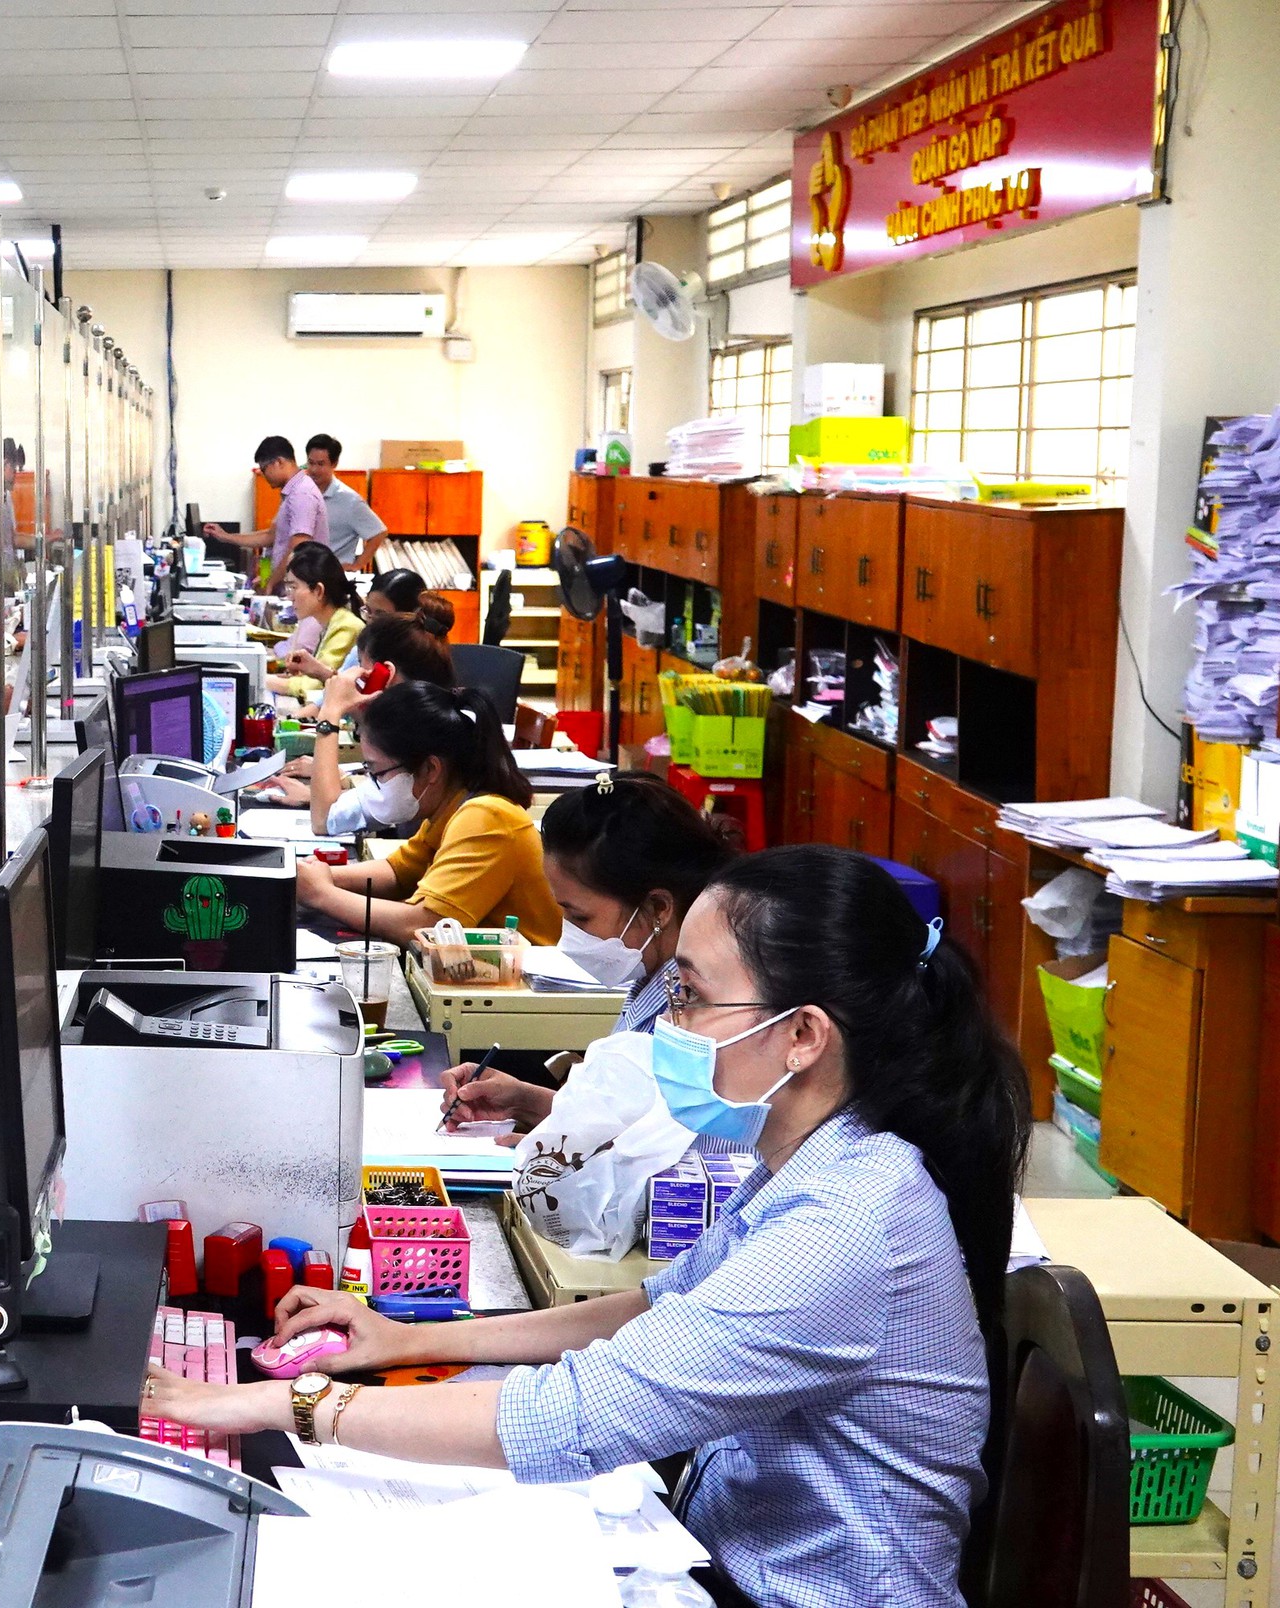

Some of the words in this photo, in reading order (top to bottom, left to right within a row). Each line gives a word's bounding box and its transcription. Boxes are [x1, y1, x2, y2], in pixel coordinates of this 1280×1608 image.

[901, 80, 927, 136] TIẾP
[929, 69, 966, 126] NHẬN
[969, 54, 988, 106] VÀ
[991, 33, 1020, 97] TRẢ
[1024, 15, 1058, 82] KẾT
[1060, 0, 1097, 64] QUẢ
[911, 135, 947, 187] QUẬN
[948, 121, 970, 172] GÒ
[971, 104, 1001, 163] VẤP
[921, 186, 960, 236] CHÍNH
